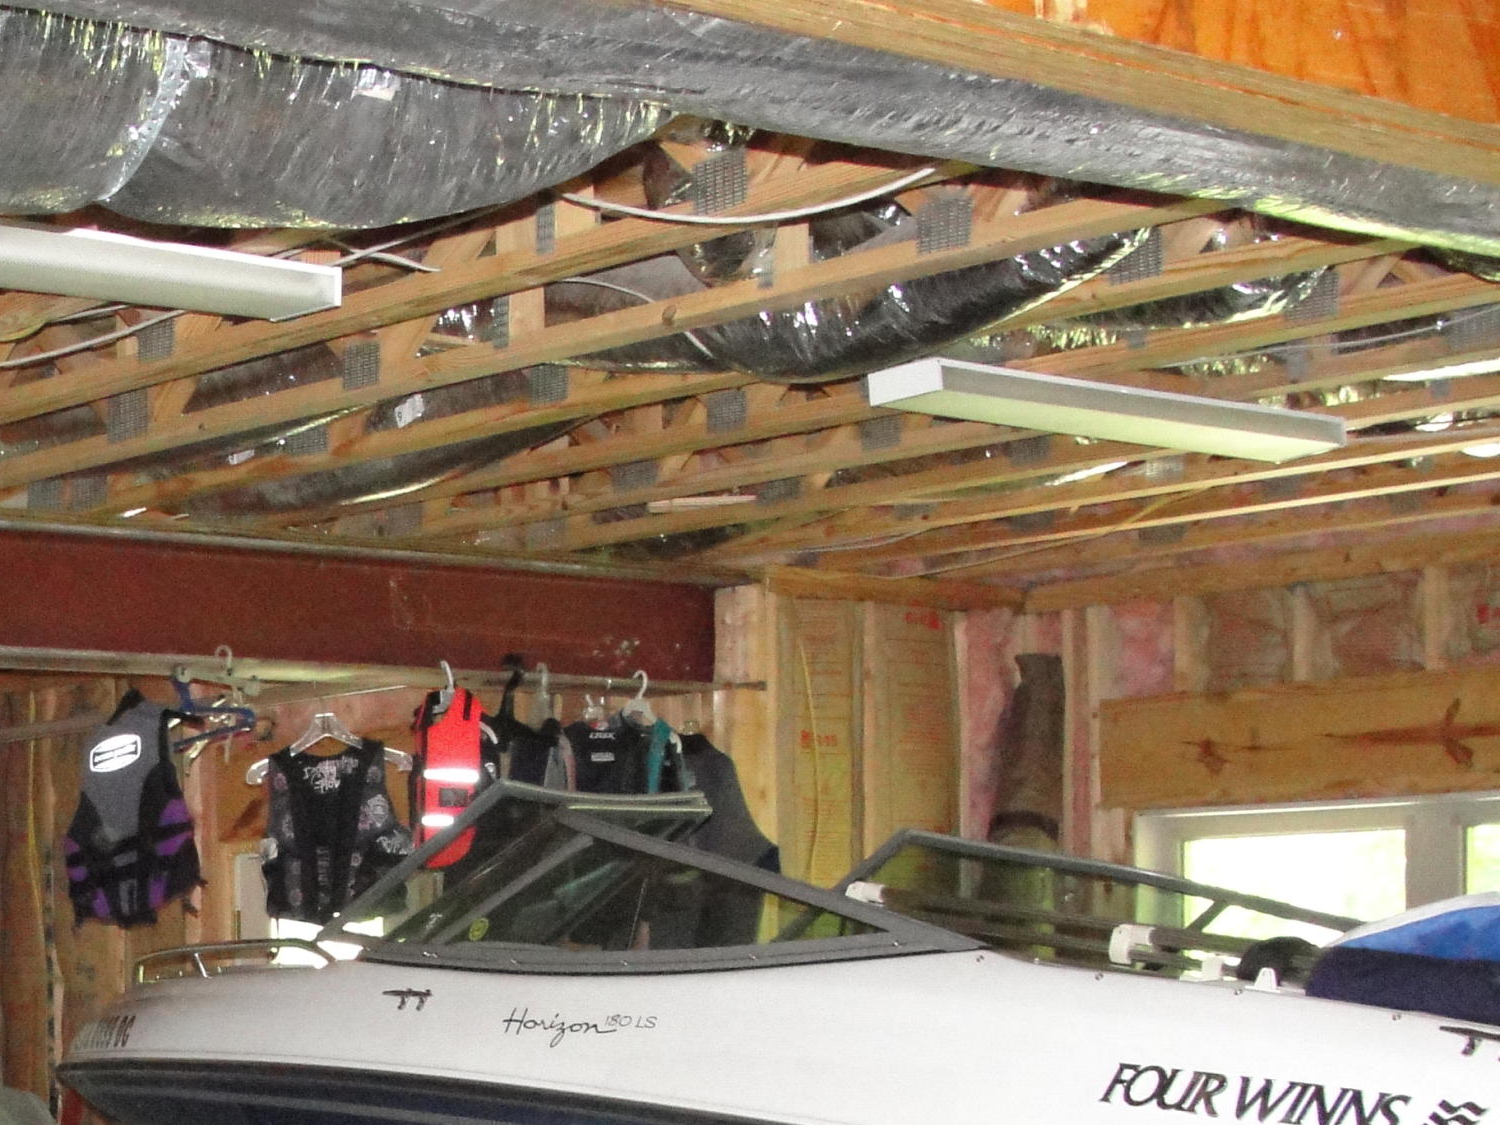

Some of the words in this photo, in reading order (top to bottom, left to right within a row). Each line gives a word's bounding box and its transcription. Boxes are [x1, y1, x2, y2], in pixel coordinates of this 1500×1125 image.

[502, 1008, 617, 1048] Horizon
[605, 1015, 632, 1027] 180
[634, 1016, 658, 1029] LS
[1100, 1062, 1228, 1118] FOUR
